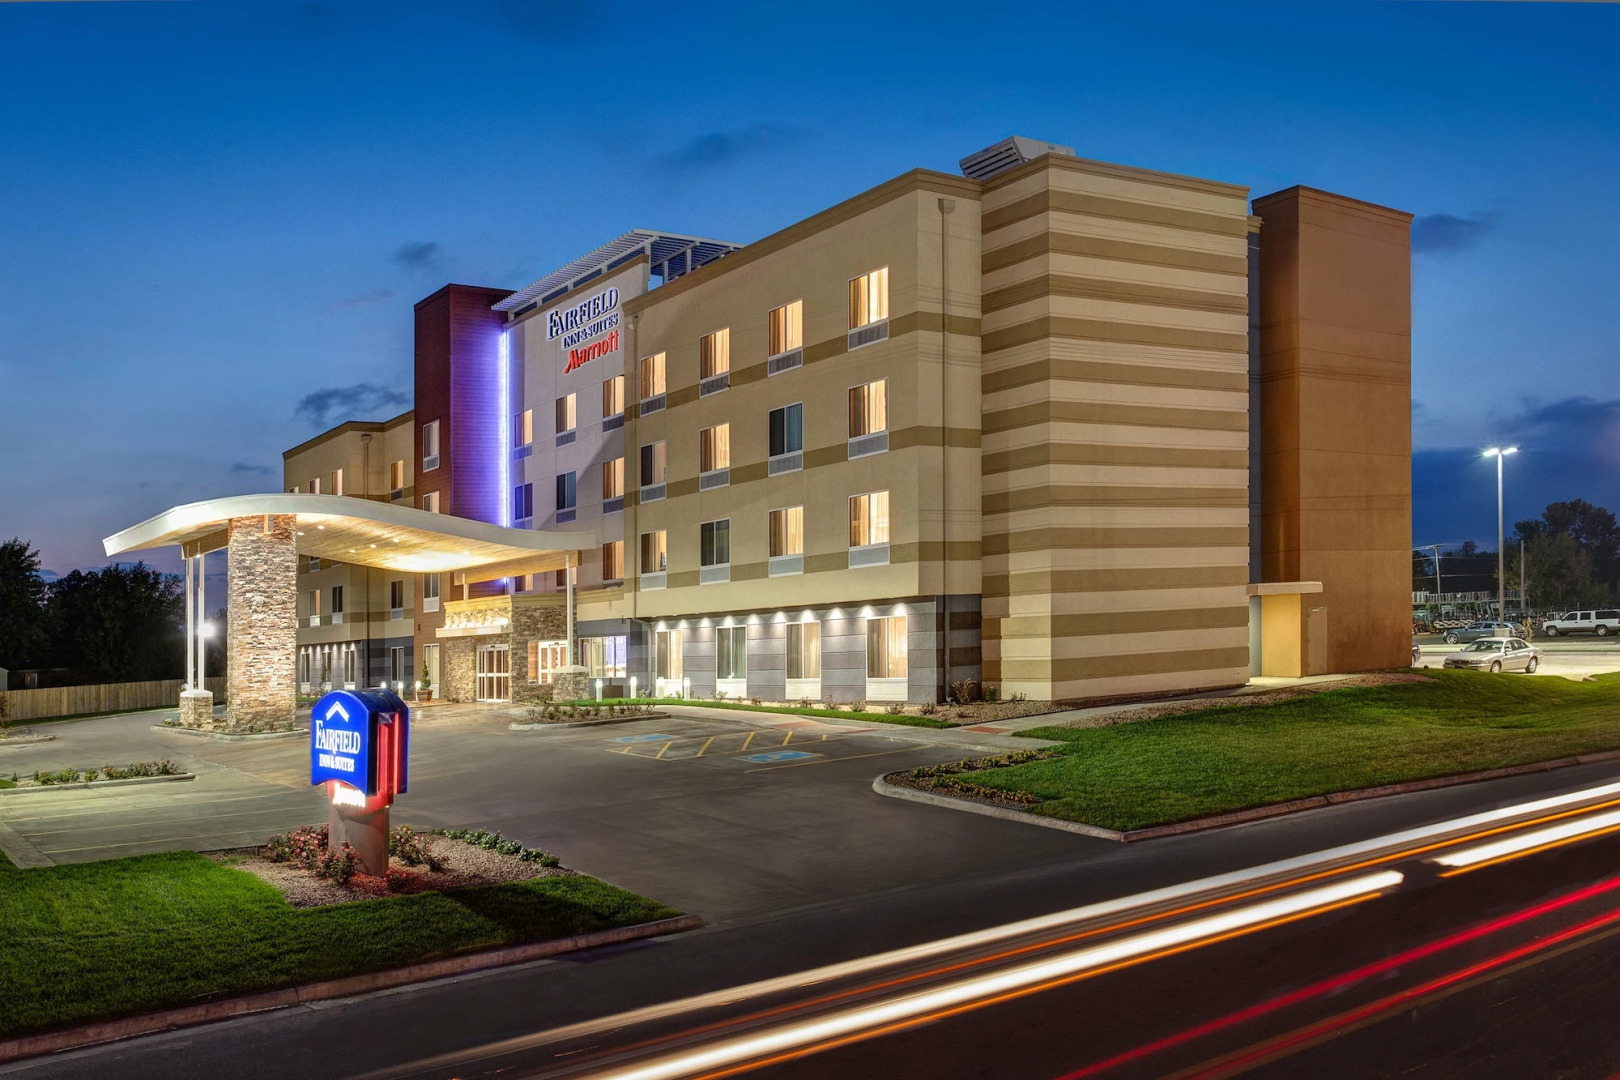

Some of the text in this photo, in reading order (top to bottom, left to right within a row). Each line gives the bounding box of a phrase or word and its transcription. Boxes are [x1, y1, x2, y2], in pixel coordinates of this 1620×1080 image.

[547, 287, 618, 340] FAIRFIELD
[563, 329, 619, 374] Marriott
[315, 720, 361, 754] FAIRFIELD
